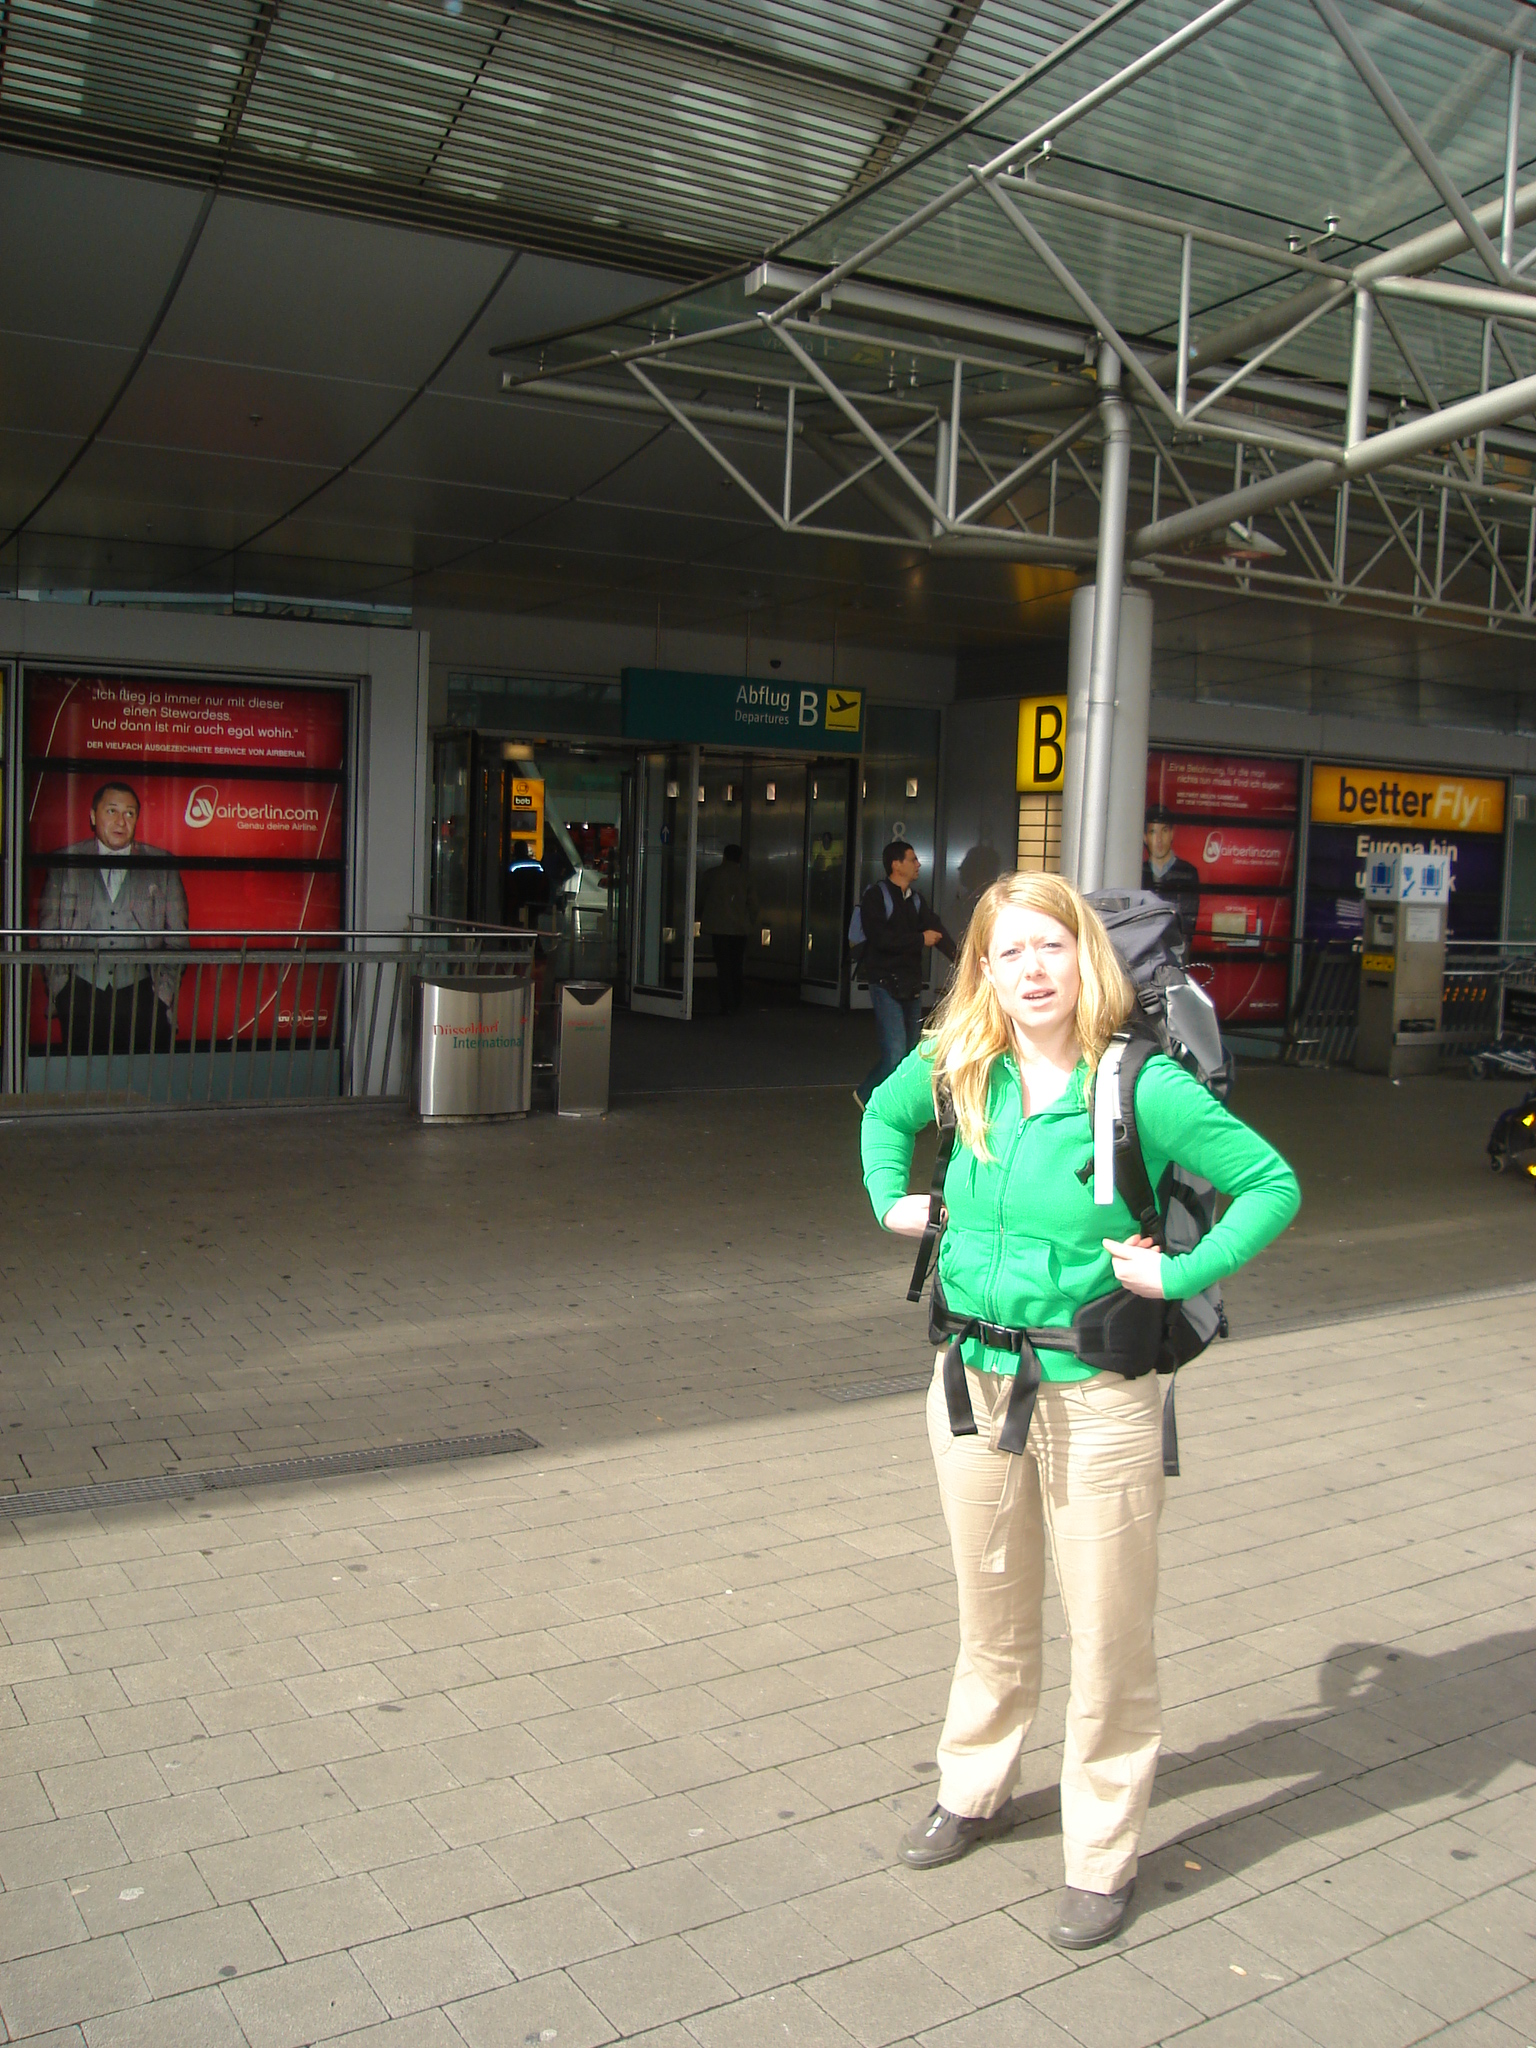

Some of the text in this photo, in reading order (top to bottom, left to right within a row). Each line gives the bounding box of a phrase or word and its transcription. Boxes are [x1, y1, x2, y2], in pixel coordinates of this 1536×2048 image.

[119, 688, 146, 705] flieg
[149, 691, 161, 706] ja
[164, 692, 201, 705] immer
[205, 696, 223, 707] nur
[227, 695, 245, 708] mit
[248, 696, 285, 710] dieser
[736, 685, 819, 727] Abflug B
[123, 706, 232, 722] einen Stewardess.
[735, 710, 790, 725] Departures
[91, 718, 116, 731] Und
[120, 719, 151, 733] dann
[155, 720, 169, 733] ist
[172, 722, 191, 735] mir
[194, 723, 224, 737] auch
[227, 725, 254, 740] egal
[86, 741, 103, 750] DER
[105, 741, 143, 751] VIELFACH
[145, 743, 212, 754] AUSGEZEICHNETE
[214, 746, 246, 756] SERVICE
[248, 747, 265, 757] VON
[1033, 705, 1064, 783] B
[216, 802, 319, 821] airberlin.com
[237, 821, 265, 830] Genau
[267, 822, 290, 831] deine
[433, 1020, 499, 1036] Düsseldorf
[453, 1033, 524, 1049] International
